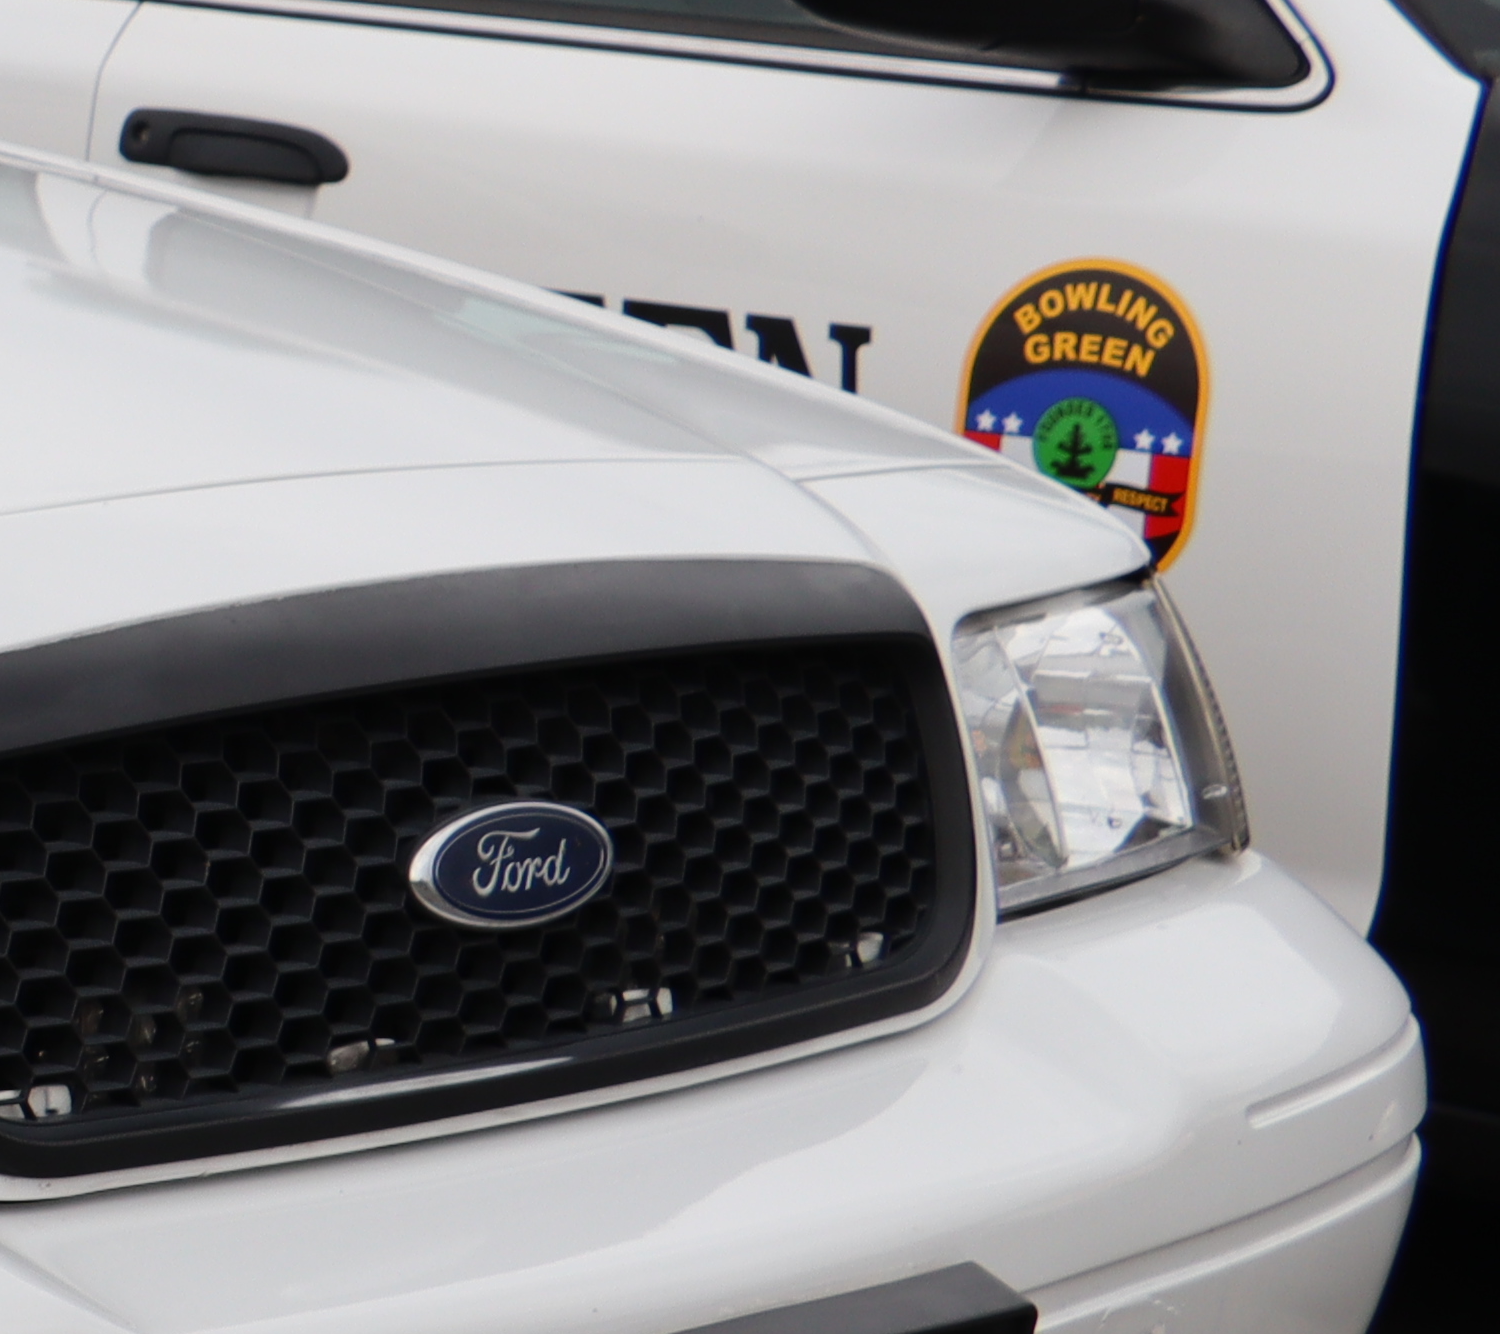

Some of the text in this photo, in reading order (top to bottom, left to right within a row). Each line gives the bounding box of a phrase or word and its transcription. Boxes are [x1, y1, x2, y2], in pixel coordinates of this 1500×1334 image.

[1013, 281, 1175, 349] BOWLING
[1023, 330, 1156, 378] GREEN
[473, 826, 571, 897] Ford
